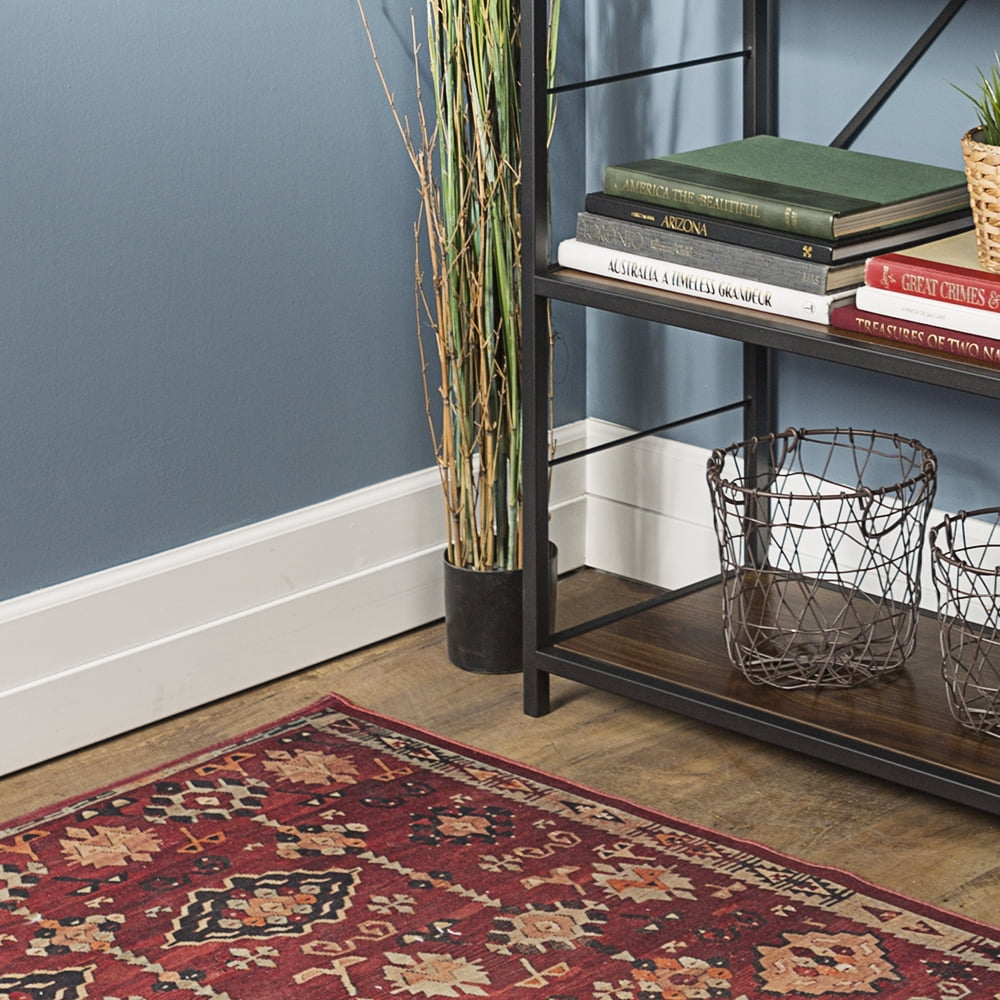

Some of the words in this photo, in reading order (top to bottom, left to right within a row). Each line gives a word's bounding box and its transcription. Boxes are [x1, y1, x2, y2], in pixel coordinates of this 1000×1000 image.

[614, 178, 671, 200] AMERICA
[672, 188, 696, 205] THE
[697, 192, 761, 219] BEAUTIFUL
[581, 219, 646, 250] TORONTO
[660, 214, 708, 237] ARIZONA
[607, 258, 659, 286] AUSTRALIA
[662, 271, 670, 285] A
[671, 272, 717, 296] TIMELESS
[718, 282, 773, 308] GRANDEUR
[901, 273, 940, 297] GREAT
[940, 281, 986, 307] CRIMES
[988, 291, 1000, 310] &
[855, 317, 926, 344] TREASURES
[926, 333, 947, 352] OF
[946, 337, 980, 358] TWO
